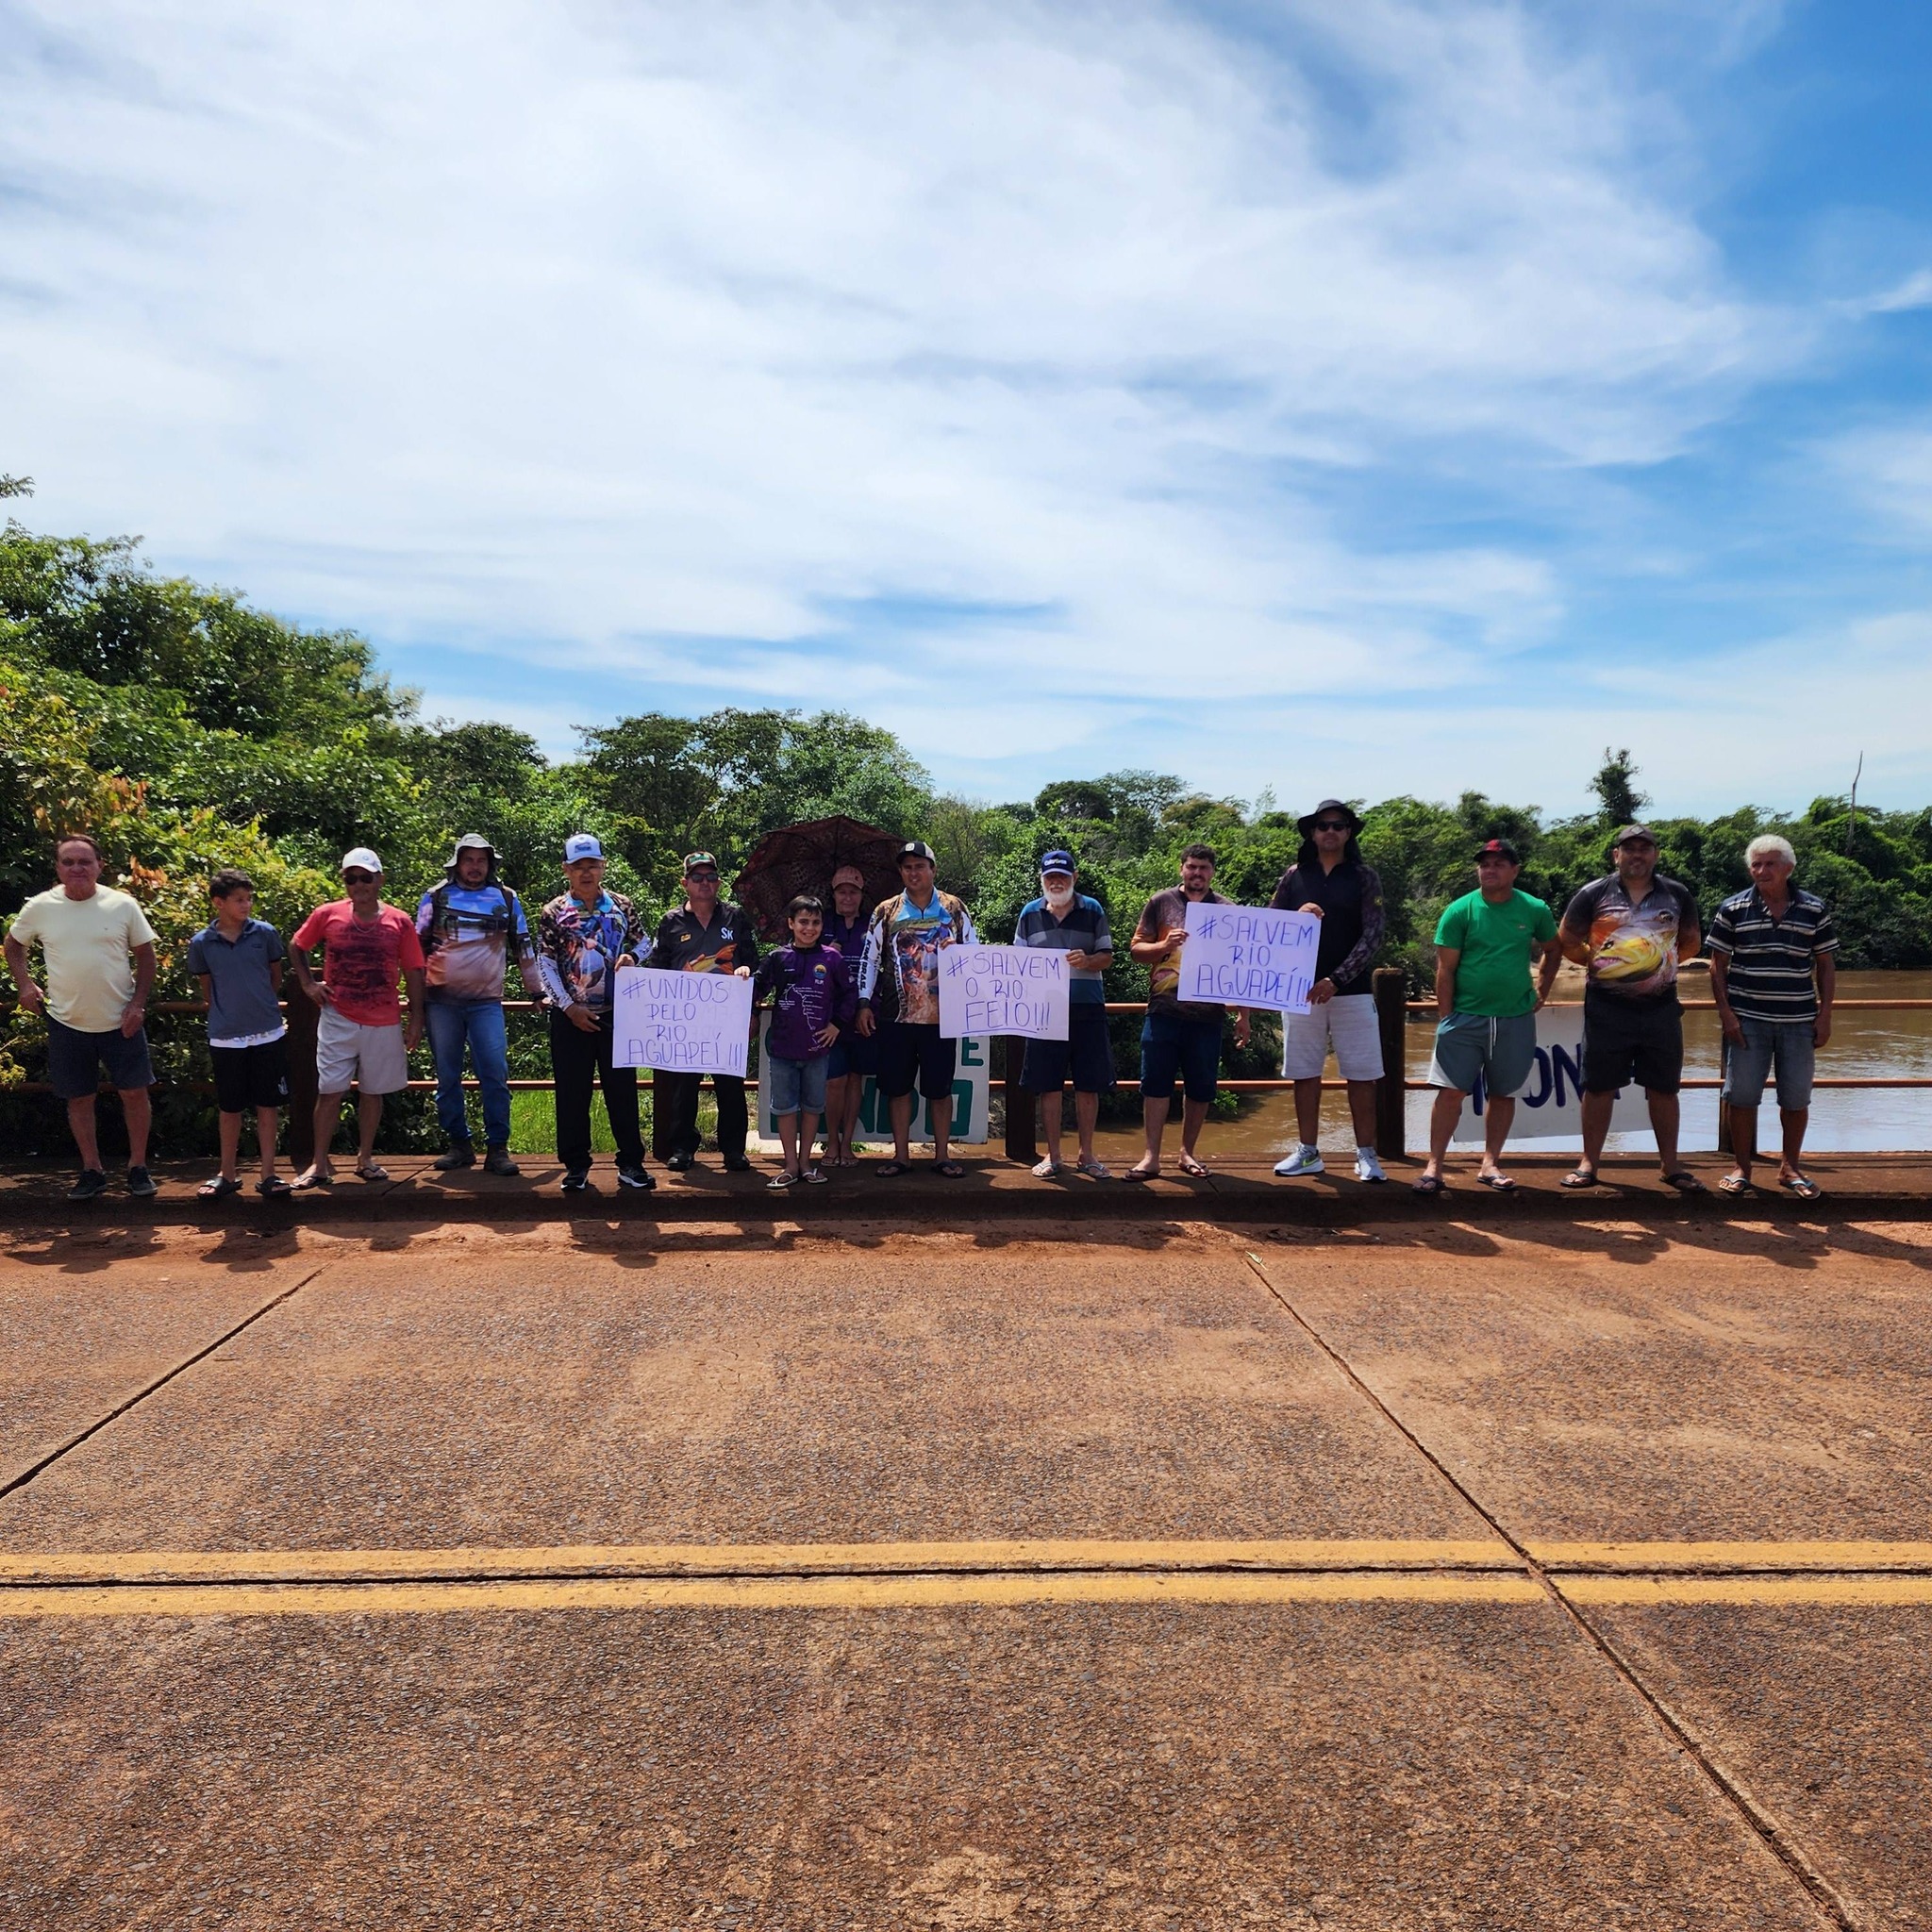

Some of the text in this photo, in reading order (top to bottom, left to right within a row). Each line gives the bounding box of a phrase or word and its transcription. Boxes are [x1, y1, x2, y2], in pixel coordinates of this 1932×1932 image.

[721, 926, 734, 941] SK
[1196, 914, 1313, 946] #SALVEM
[946, 952, 1060, 980] #SALVEM
[1228, 943, 1271, 967] RIO
[622, 974, 729, 1003] #UNIDOS
[965, 977, 1024, 1000] O RIO
[645, 1003, 696, 1022] PELO
[646, 1024, 687, 1041] RIO
